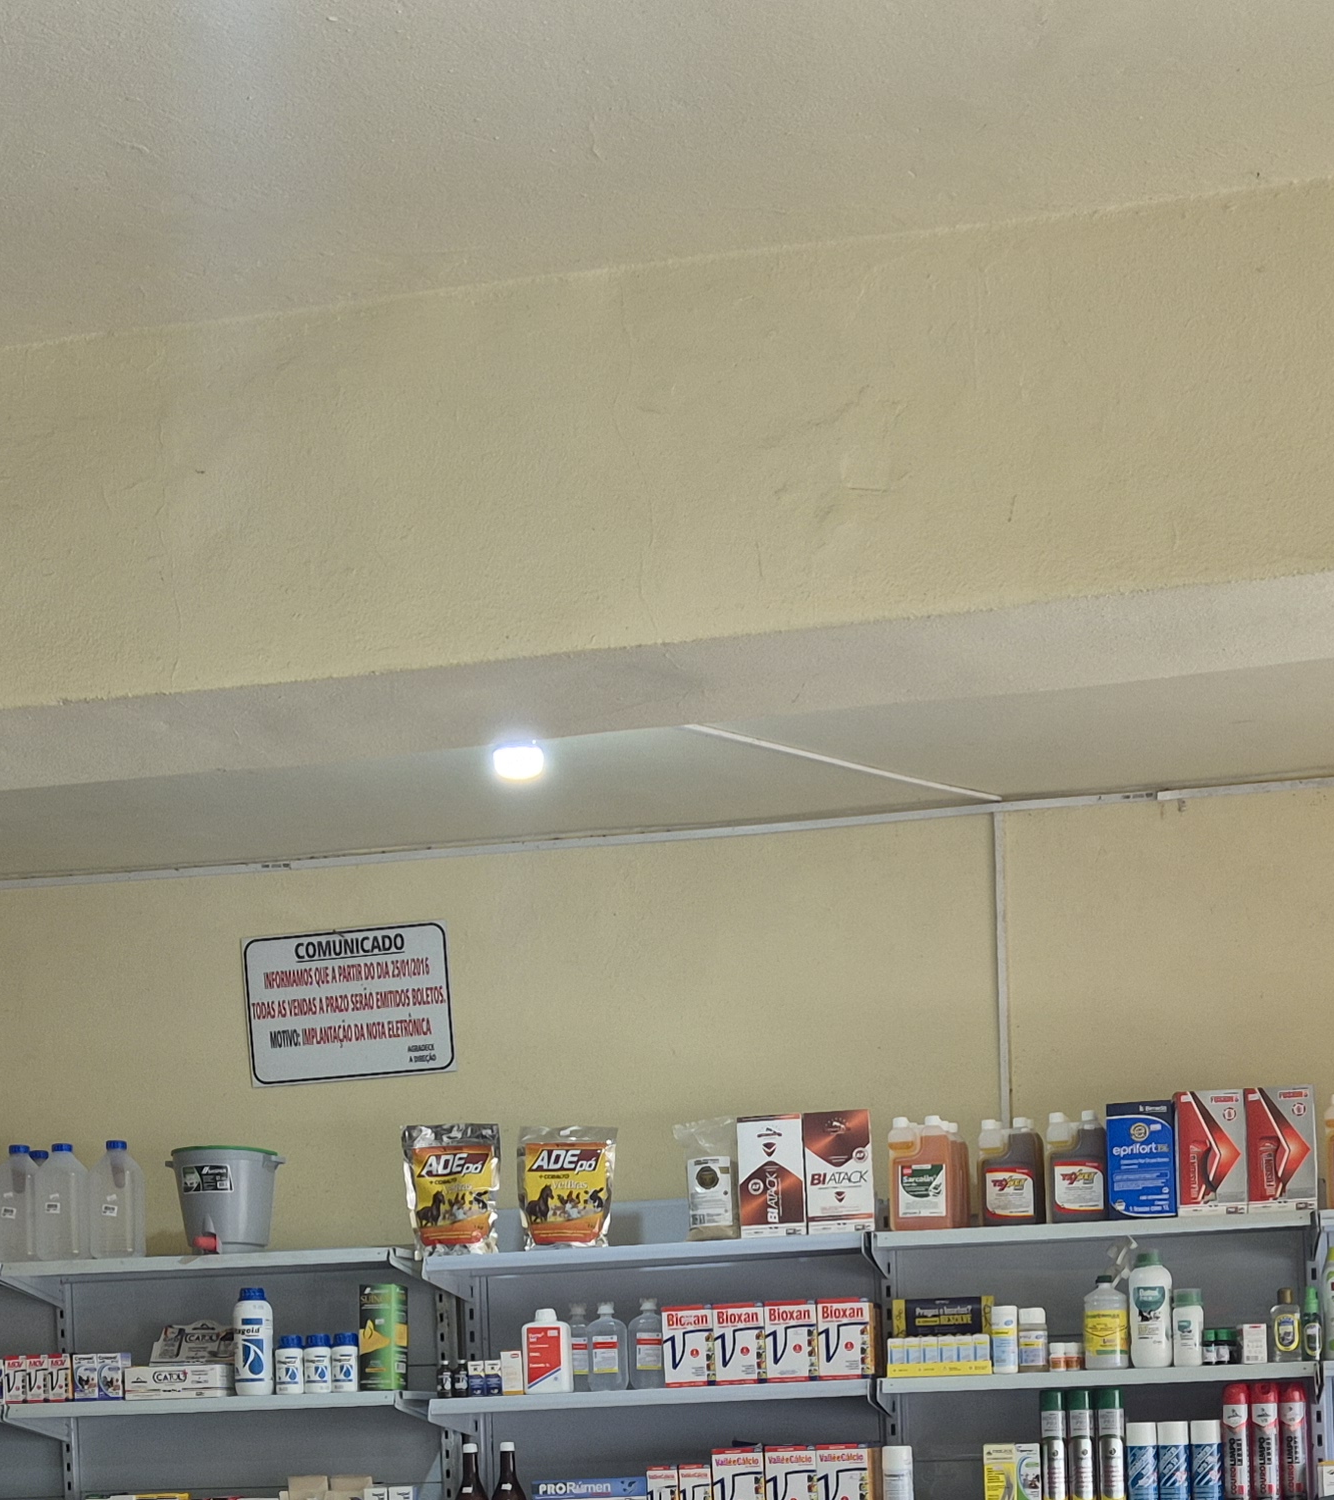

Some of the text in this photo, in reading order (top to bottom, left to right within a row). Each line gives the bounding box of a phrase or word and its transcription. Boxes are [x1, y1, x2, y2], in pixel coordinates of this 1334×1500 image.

[294, 933, 405, 960] COMUNICADO
[263, 957, 430, 990] INFORMAMOS QUE A PARTIR DO DIA 25/01/2016
[251, 985, 447, 1021] TODAS AS VENDAS A PRAZO SERÃO EMITIDOS BOLETOS.
[269, 1013, 433, 1049] MOTIVO: IMPLANTAÇÃO DA NOTA ELETRÔNICA
[1112, 1142, 1157, 1156] eprifort
[810, 1170, 869, 1187] BIATACK
[667, 1313, 708, 1327] Bioxan
[717, 1310, 759, 1325] Bioxan
[768, 1308, 810, 1322] Bioxan
[821, 1306, 863, 1320] Bioxan
